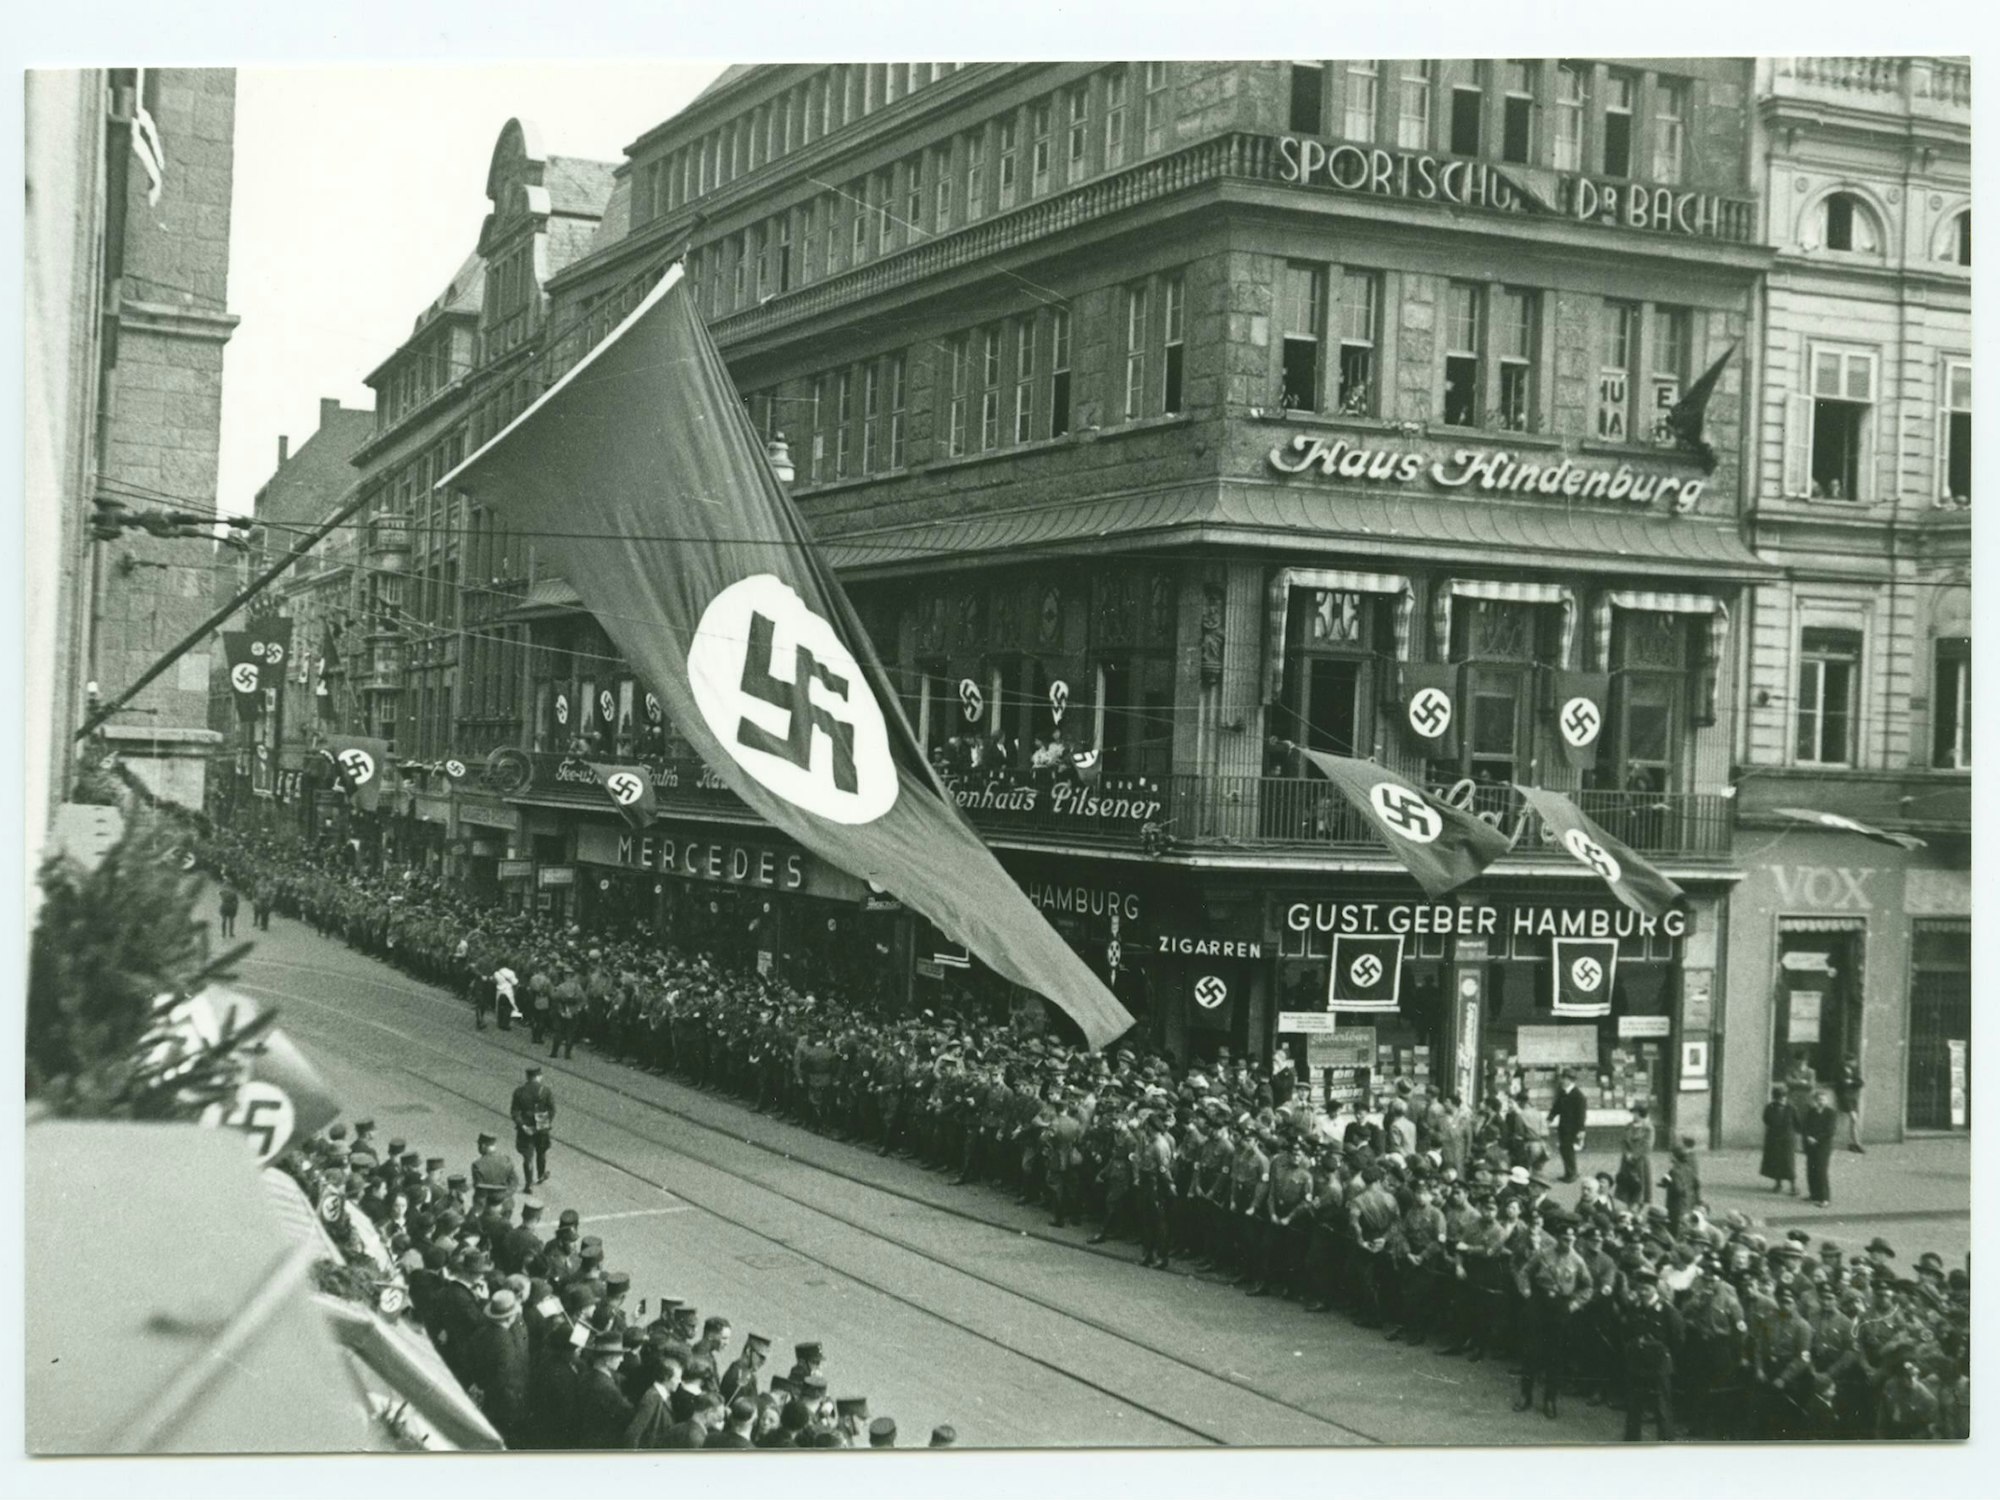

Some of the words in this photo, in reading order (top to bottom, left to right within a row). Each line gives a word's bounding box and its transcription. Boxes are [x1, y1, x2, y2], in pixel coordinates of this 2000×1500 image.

[1279, 136, 1521, 210] SPORTSCHU
[1629, 184, 1720, 237] BACH
[1269, 435, 1424, 482] Haus
[1431, 449, 1706, 513] Hindenburg
[1051, 782, 1161, 819] Pilsener
[618, 835, 802, 887] MERCEDES
[1029, 882, 1140, 919] HAMBURG
[1770, 864, 1876, 909] VOX
[1287, 903, 1378, 932] GUST.
[1388, 905, 1497, 935] GEBER
[1513, 908, 1686, 936] HAMBURG
[1159, 935, 1261, 959] ZIGARREN
